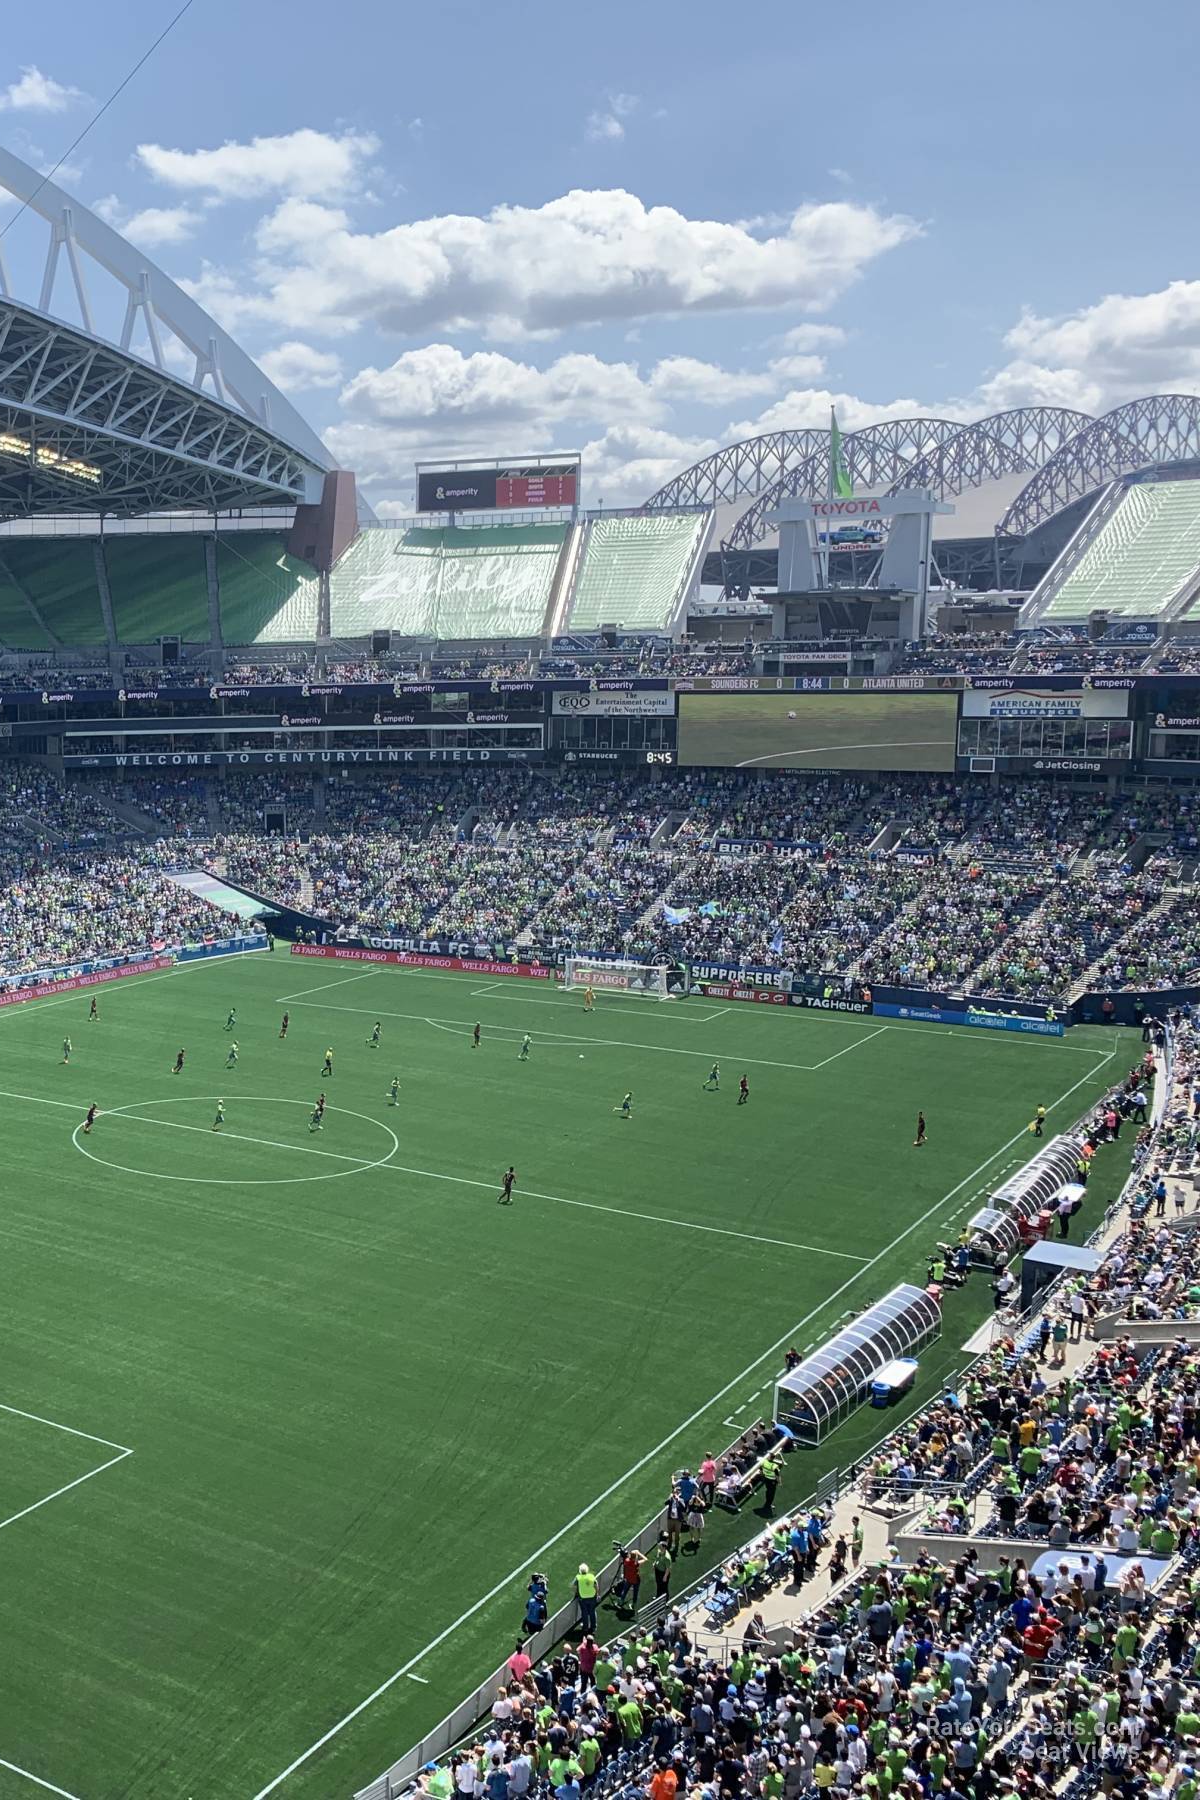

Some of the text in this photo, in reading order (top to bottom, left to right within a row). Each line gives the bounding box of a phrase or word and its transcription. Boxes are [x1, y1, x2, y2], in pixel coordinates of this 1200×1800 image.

[445, 487, 479, 498] amperity
[811, 500, 881, 516] TOYOTA
[831, 543, 872, 551] UNDRA
[402, 684, 435, 693] amperity
[500, 682, 534, 691] amperity
[599, 681, 634, 690] amperity
[711, 678, 924, 689] SOUNDERS FC 0 8:44 0 ATLANTA UNITED
[975, 679, 1014, 688] amperity
[1094, 679, 1136, 688] amperity
[127, 690, 158, 700] amperity
[218, 688, 250, 698] amperity
[310, 686, 343, 695] amperity
[625, 691, 637, 699] The
[49, 693, 73, 702] amperity
[595, 697, 668, 706] Entertainment Capital
[290, 716, 322, 725] amperity
[382, 714, 415, 723] amperity
[476, 713, 509, 722] amperity
[115, 750, 491, 766] WELCOME TO CENTURYLINK FIELD
[646, 752, 672, 763] 8:45
[1045, 761, 1101, 771] JetClosing
[300, 946, 326, 956] FARGO
[370, 937, 470, 956] GORILLA FC
[335, 950, 387, 962] WELLS FARGO
[397, 954, 451, 968] WELLS FARGO
[119, 968, 138, 977] WELLS
[138, 962, 157, 973] FARGO
[461, 960, 519, 974] WELLS FARGO
[530, 967, 549, 977] WEL
[79, 971, 117, 986] WELLS FARGO
[556, 969, 627, 986] WLLS FARGO
[36, 980, 76, 996] WELLS FARGO
[12, 991, 33, 1003] FARGO
[910, 1009, 942, 1020] SeatGeek
[969, 1014, 1007, 1028] alcatel
[1020, 1020, 1060, 1034] alcatel
[565, 1663, 576, 1675] 24
